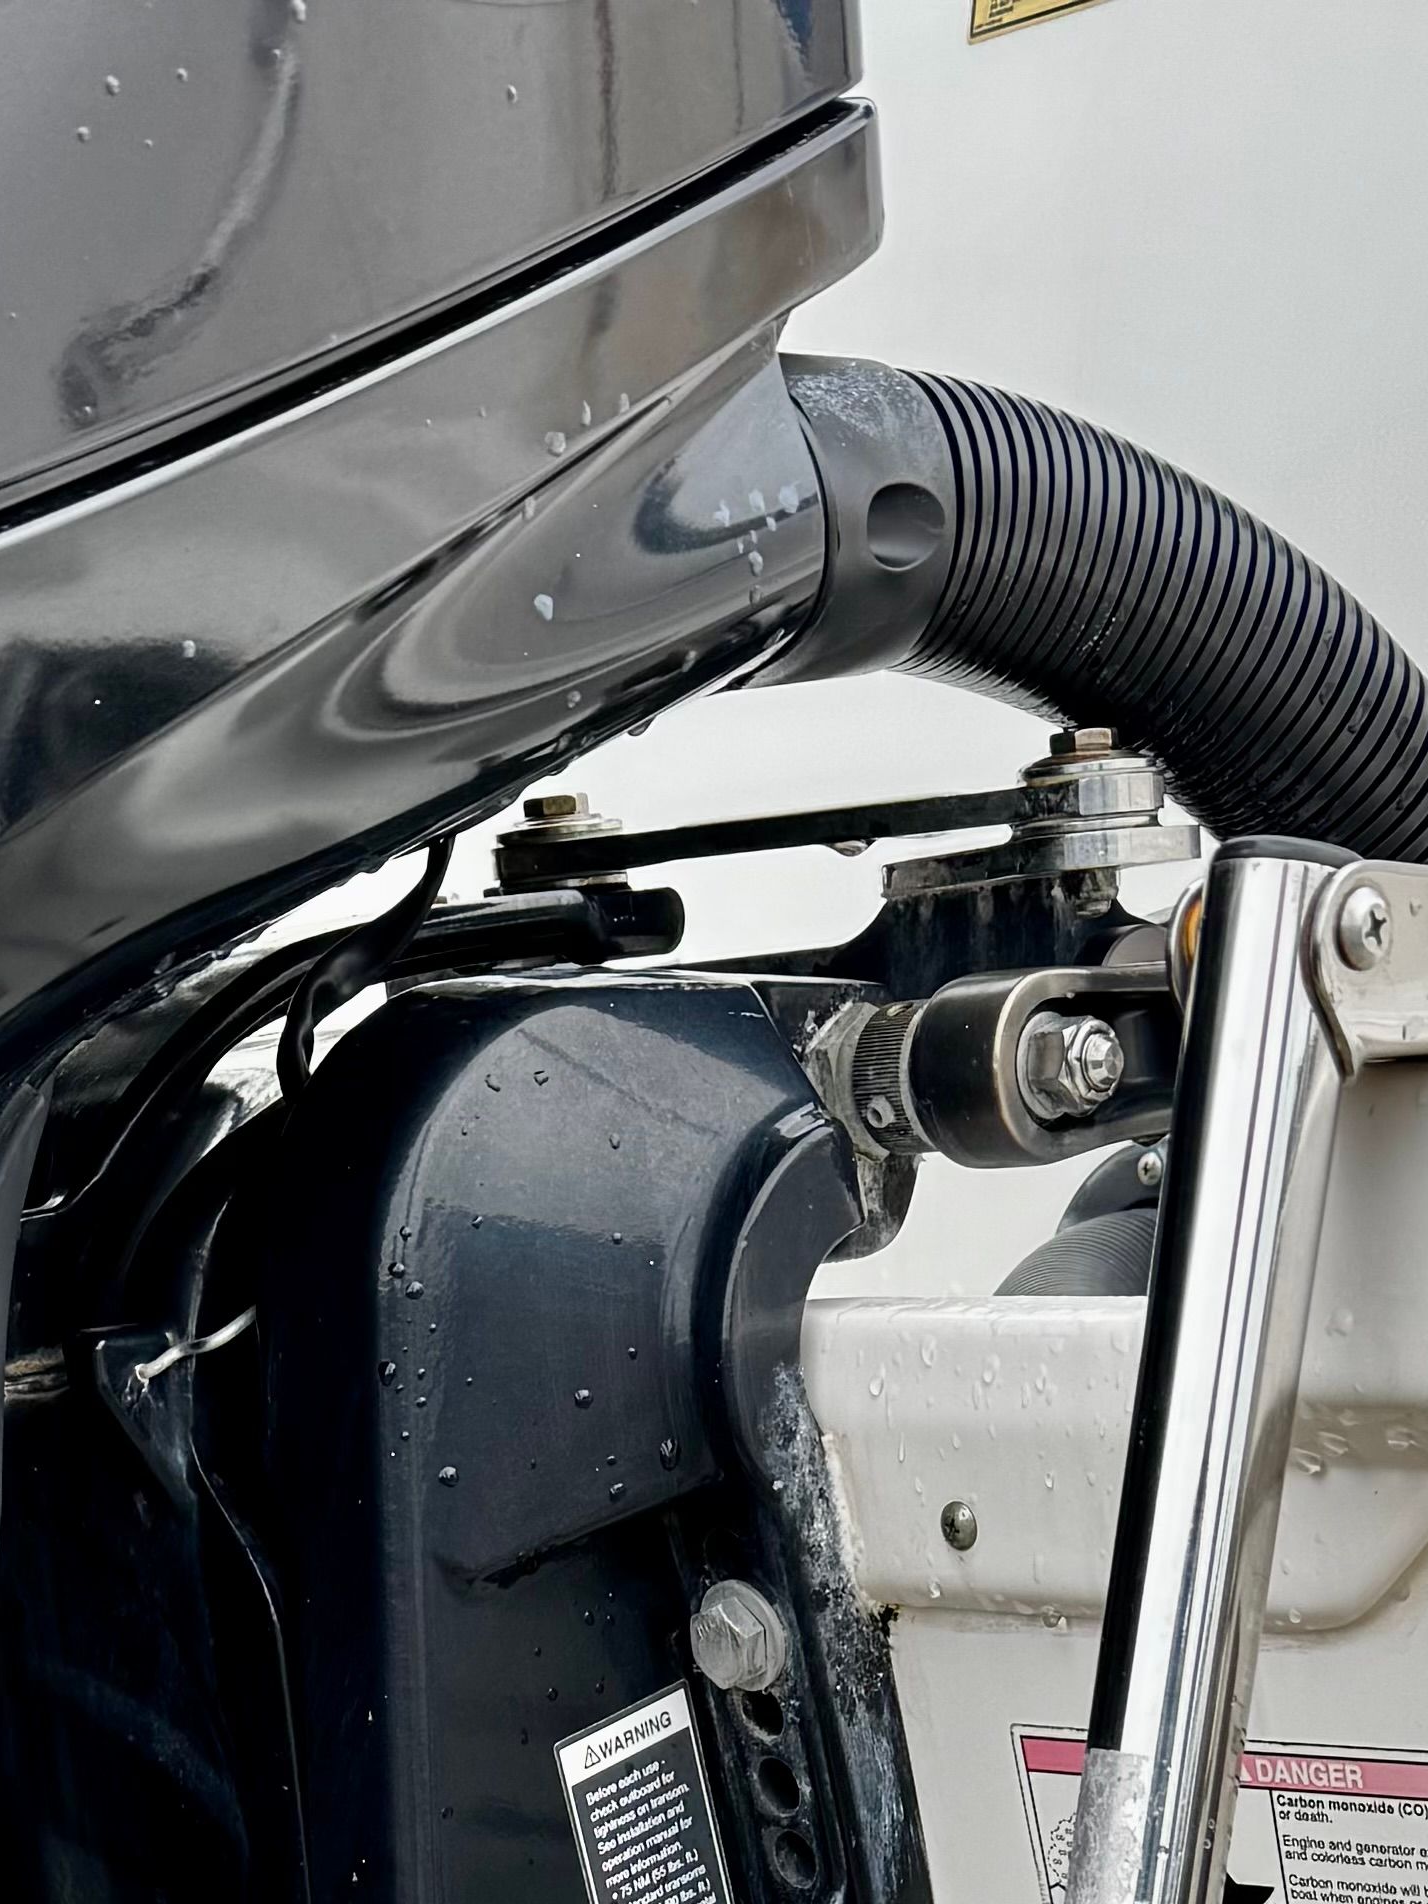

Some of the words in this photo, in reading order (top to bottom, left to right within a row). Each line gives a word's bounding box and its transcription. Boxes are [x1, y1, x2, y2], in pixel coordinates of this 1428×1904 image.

[599, 1711, 672, 1759] WARNING
[585, 1783, 617, 1806] Before
[618, 1769, 642, 1789] each
[642, 1761, 659, 1777] use
[1255, 1758, 1364, 1790] DANGER
[590, 1799, 619, 1822] check
[619, 1776, 661, 1807] outboard
[661, 1771, 675, 1785] for
[1276, 1794, 1325, 1810] Carbon
[1328, 1800, 1394, 1814] monoxide
[1398, 1802, 1428, 1820] (CO)
[593, 1810, 636, 1839] tightness
[637, 1803, 650, 1816] on
[597, 1839, 617, 1855] See
[667, 1799, 685, 1819] and
[1279, 1810, 1291, 1820] or
[1294, 1809, 1333, 1824] death.
[602, 1842, 645, 1872] operation
[646, 1821, 679, 1849] manual
[680, 1816, 692, 1831] for
[1282, 1834, 1325, 1851] Engine
[1329, 1839, 1352, 1852] and
[1355, 1843, 1416, 1856] generator
[1285, 1849, 1308, 1861] and
[1311, 1851, 1366, 1866] colorless
[1368, 1857, 1412, 1870] carbon
[605, 1869, 630, 1889] more
[619, 1883, 633, 1899] 75
[651, 1864, 667, 1884] (55
[664, 1864, 706, 1893] transoms
[1289, 1874, 1333, 1889] Carbon
[1337, 1881, 1397, 1895] monoxide
[1400, 1884, 1420, 1897] will
[1290, 1888, 1318, 1901] boat
[1320, 1891, 1353, 1904] when
